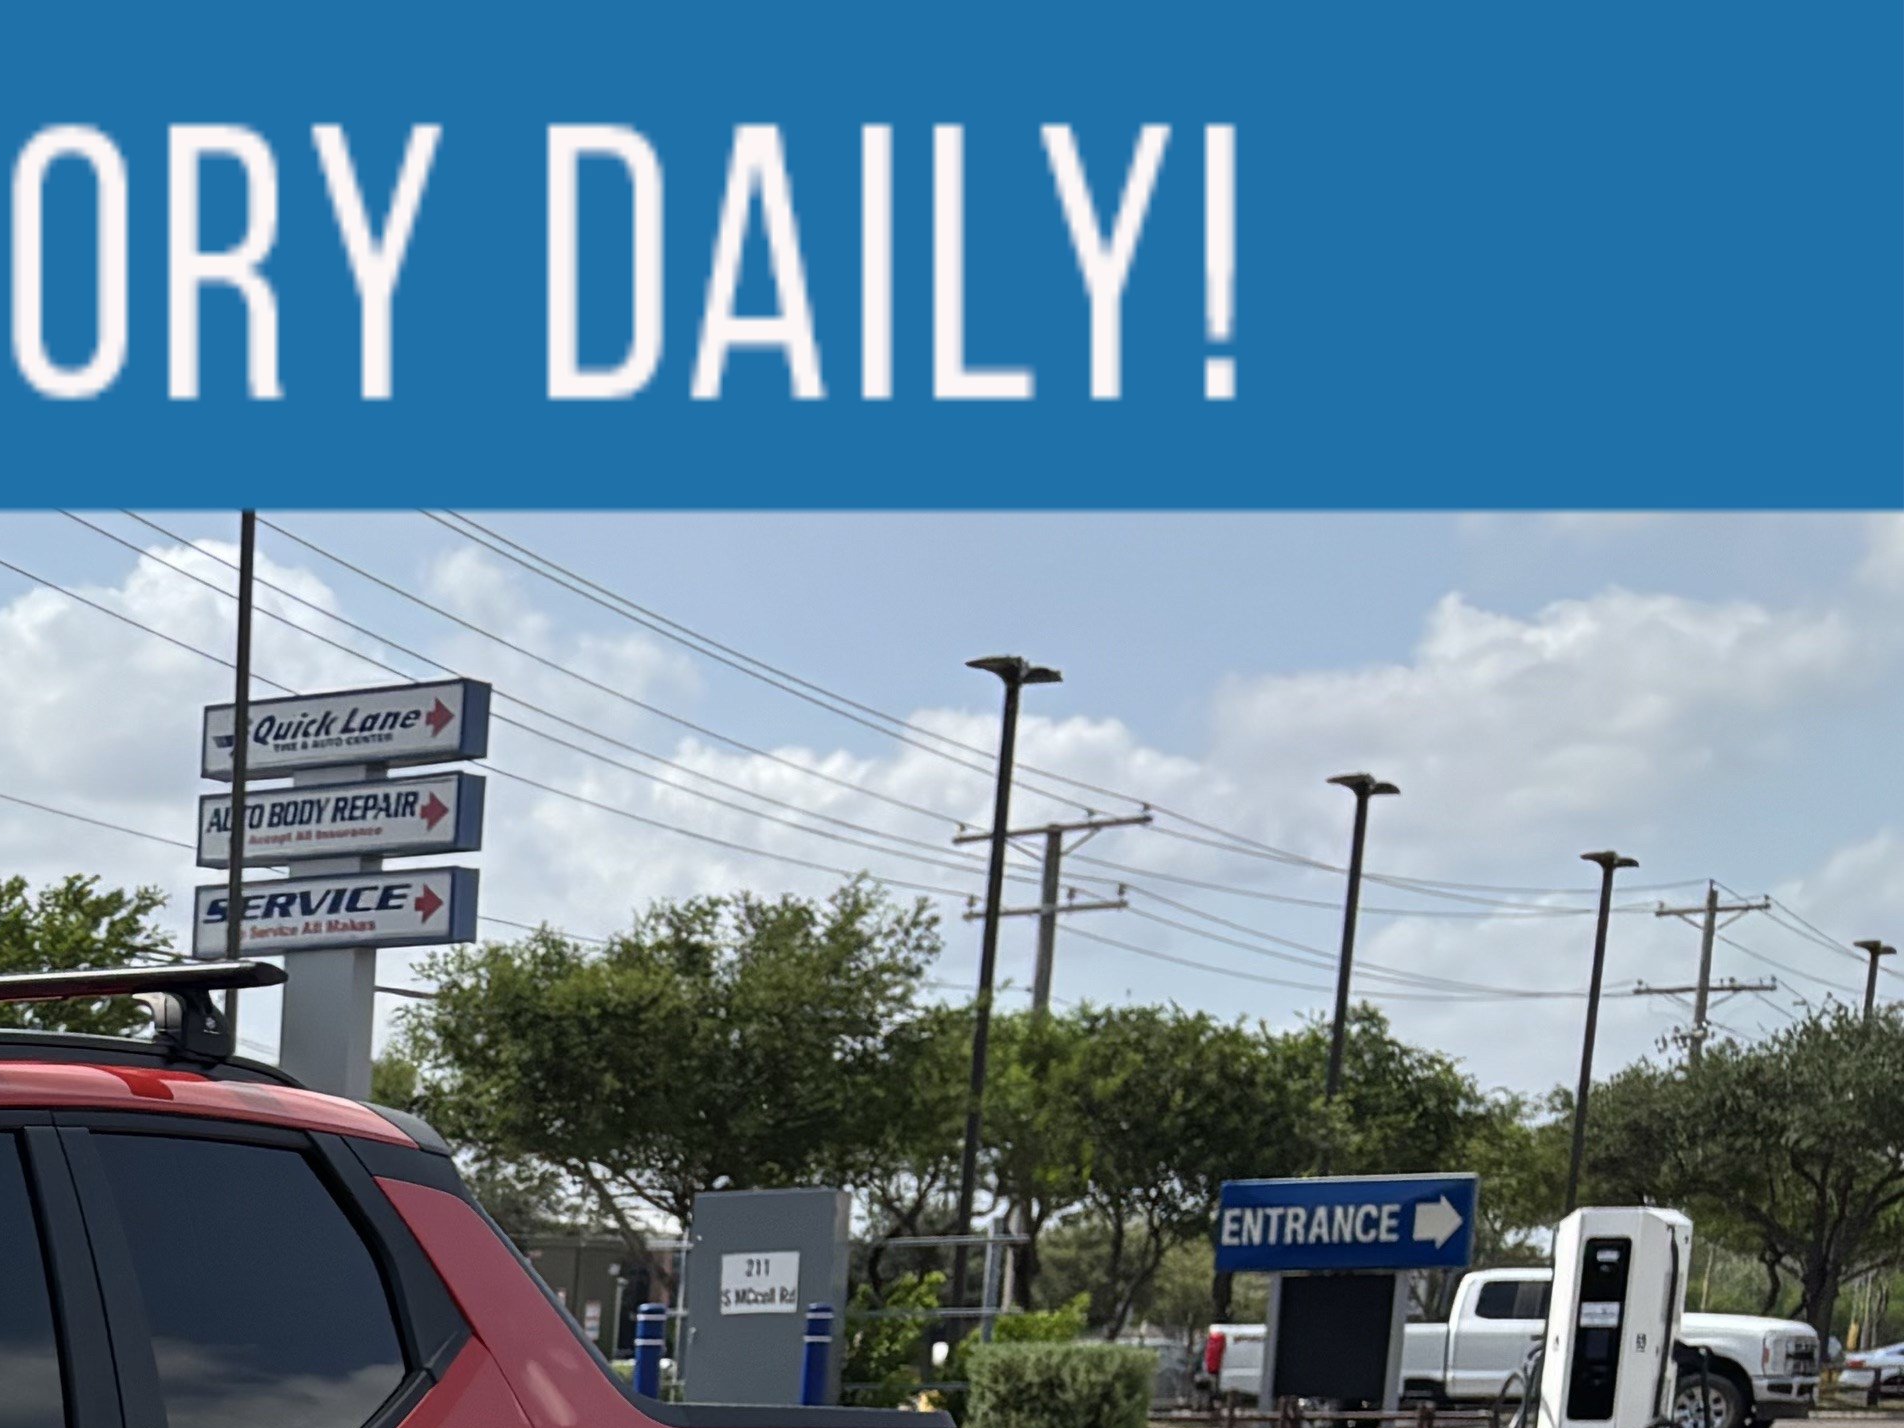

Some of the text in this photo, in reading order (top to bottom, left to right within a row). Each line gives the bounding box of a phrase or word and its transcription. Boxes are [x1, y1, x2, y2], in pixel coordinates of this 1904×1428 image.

[253, 707, 421, 746] Quick Lane
[268, 797, 333, 829] BODY
[331, 791, 420, 823] REPAIR
[203, 883, 413, 924] SERVICE
[1221, 1204, 1401, 1247] ENTRANCE
[745, 1258, 770, 1277] 211
